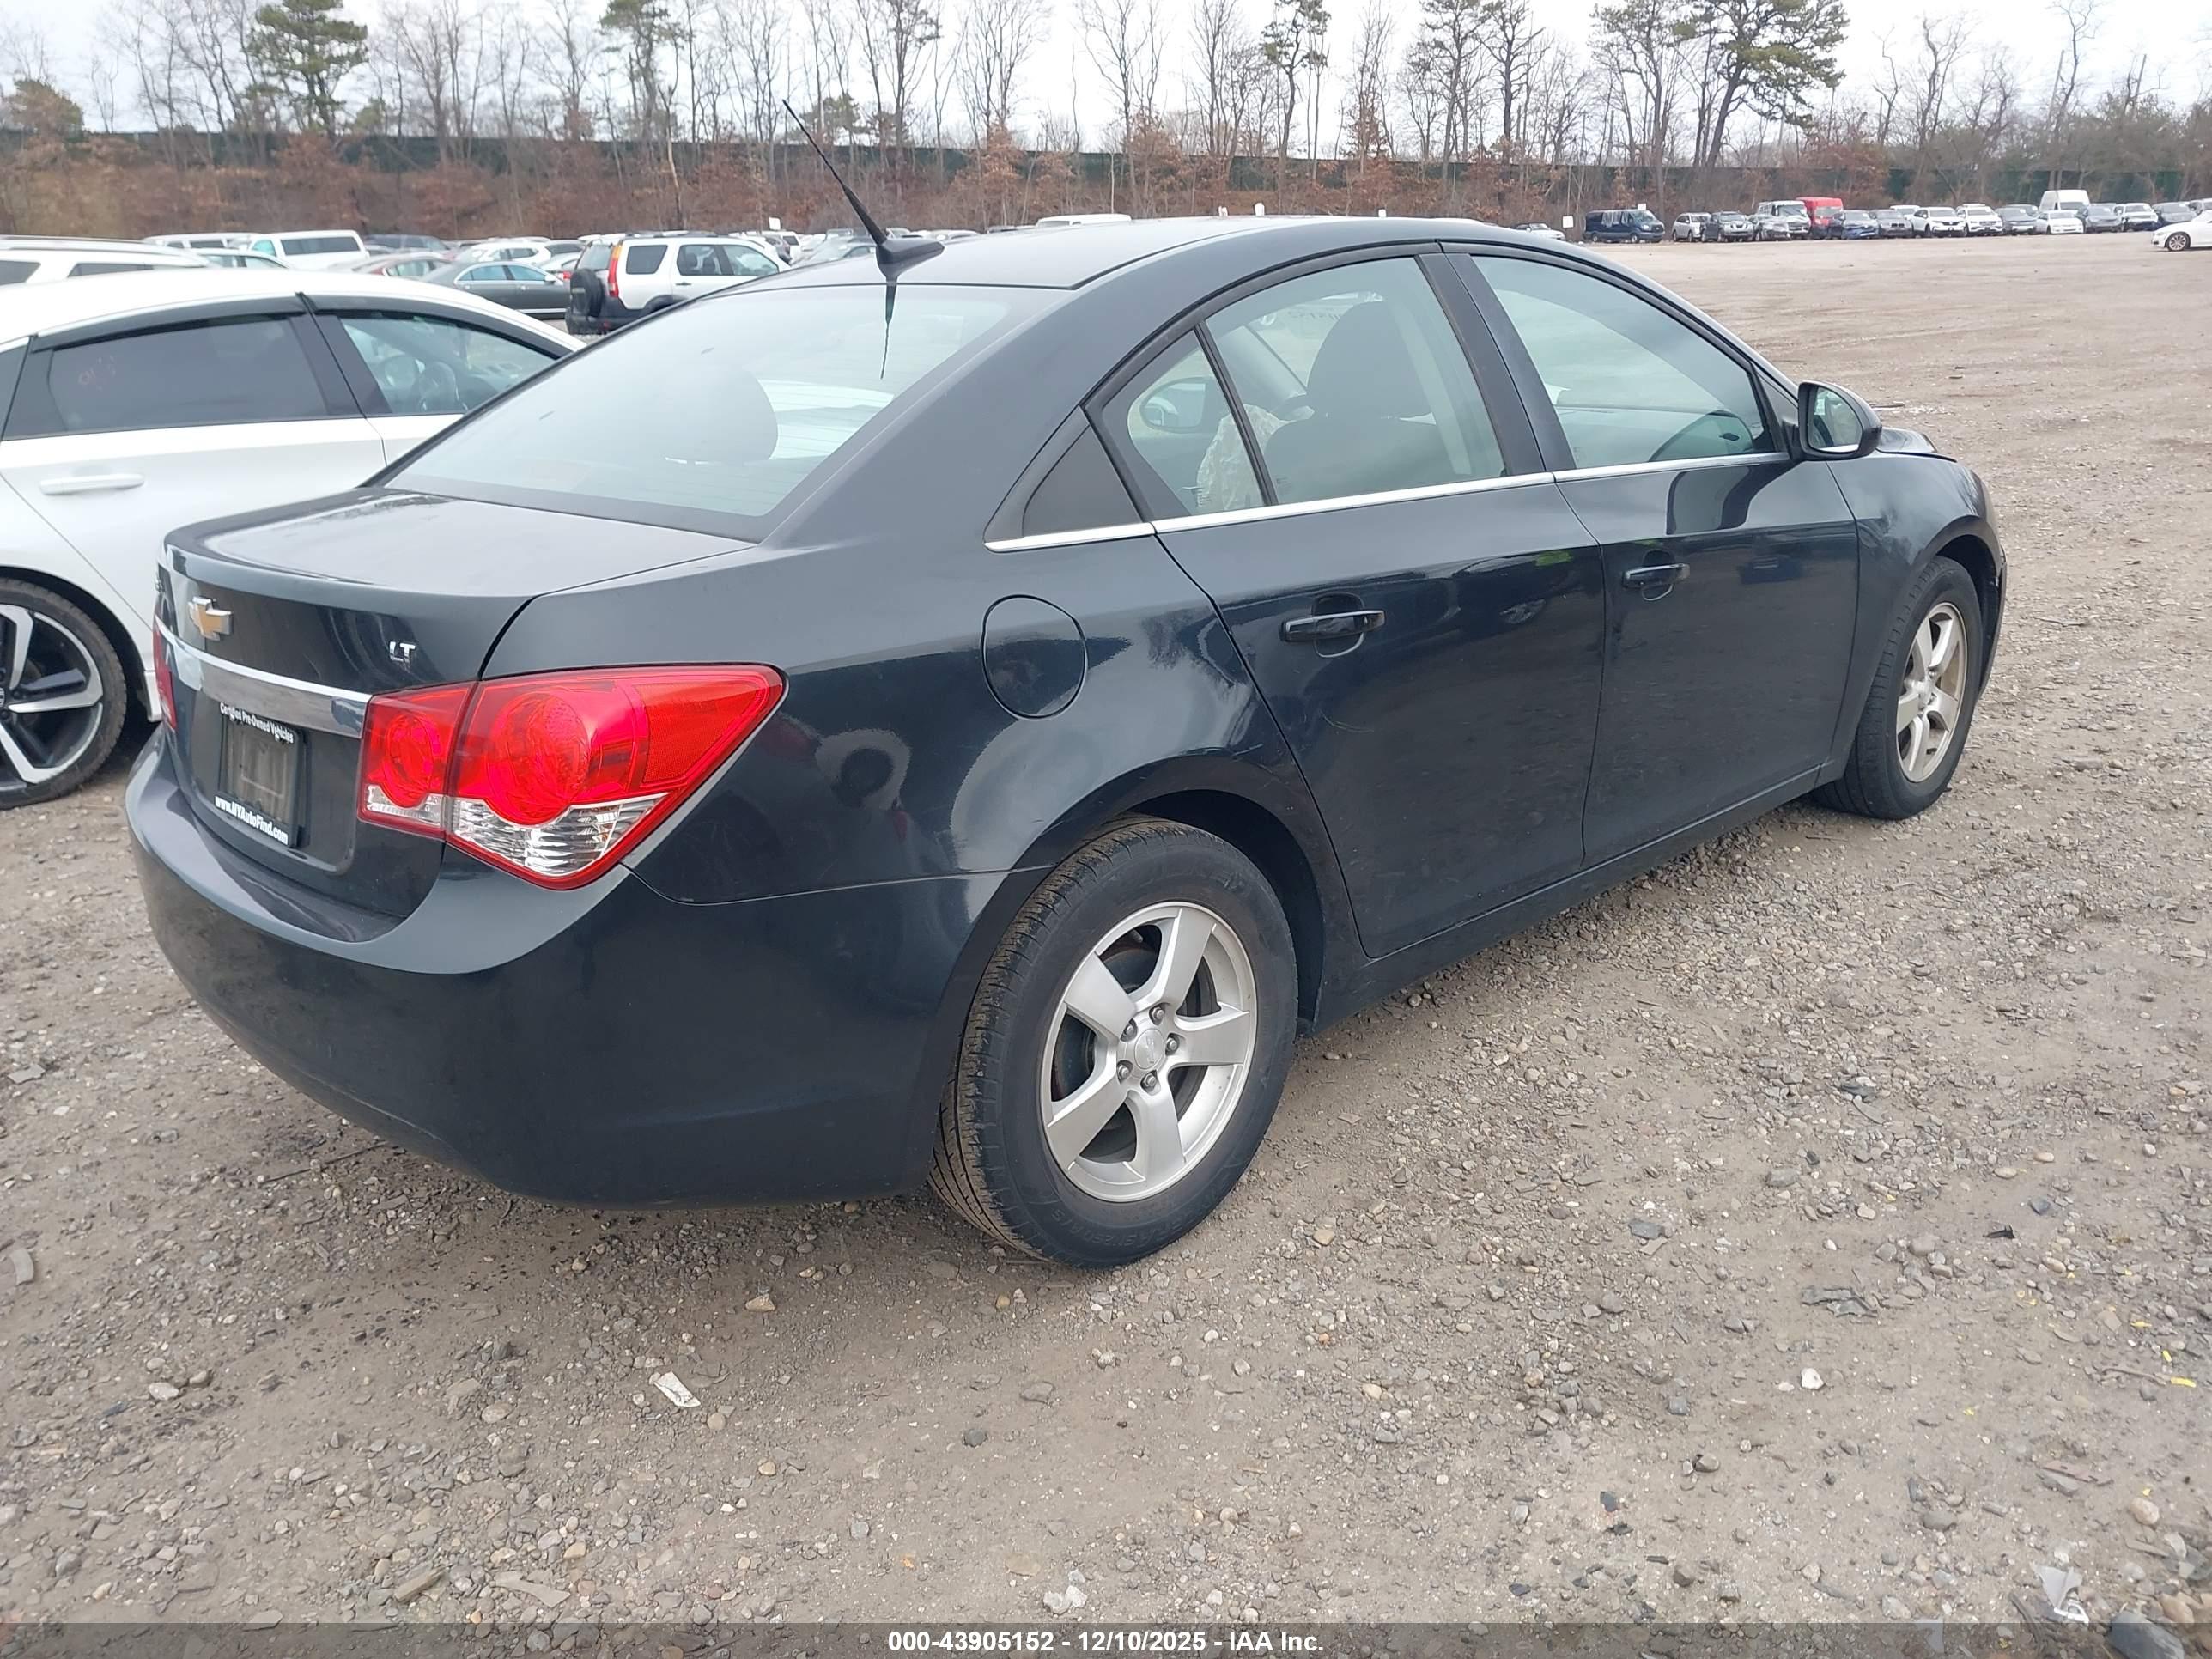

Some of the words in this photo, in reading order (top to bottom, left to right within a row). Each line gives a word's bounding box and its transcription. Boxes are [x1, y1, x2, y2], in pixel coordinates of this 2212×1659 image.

[390, 641, 416, 663] LT
[241, 710, 270, 733] Pre-Owned
[270, 720, 294, 744] Vehicles
[215, 795, 289, 846] www.NYAutoFind.com
